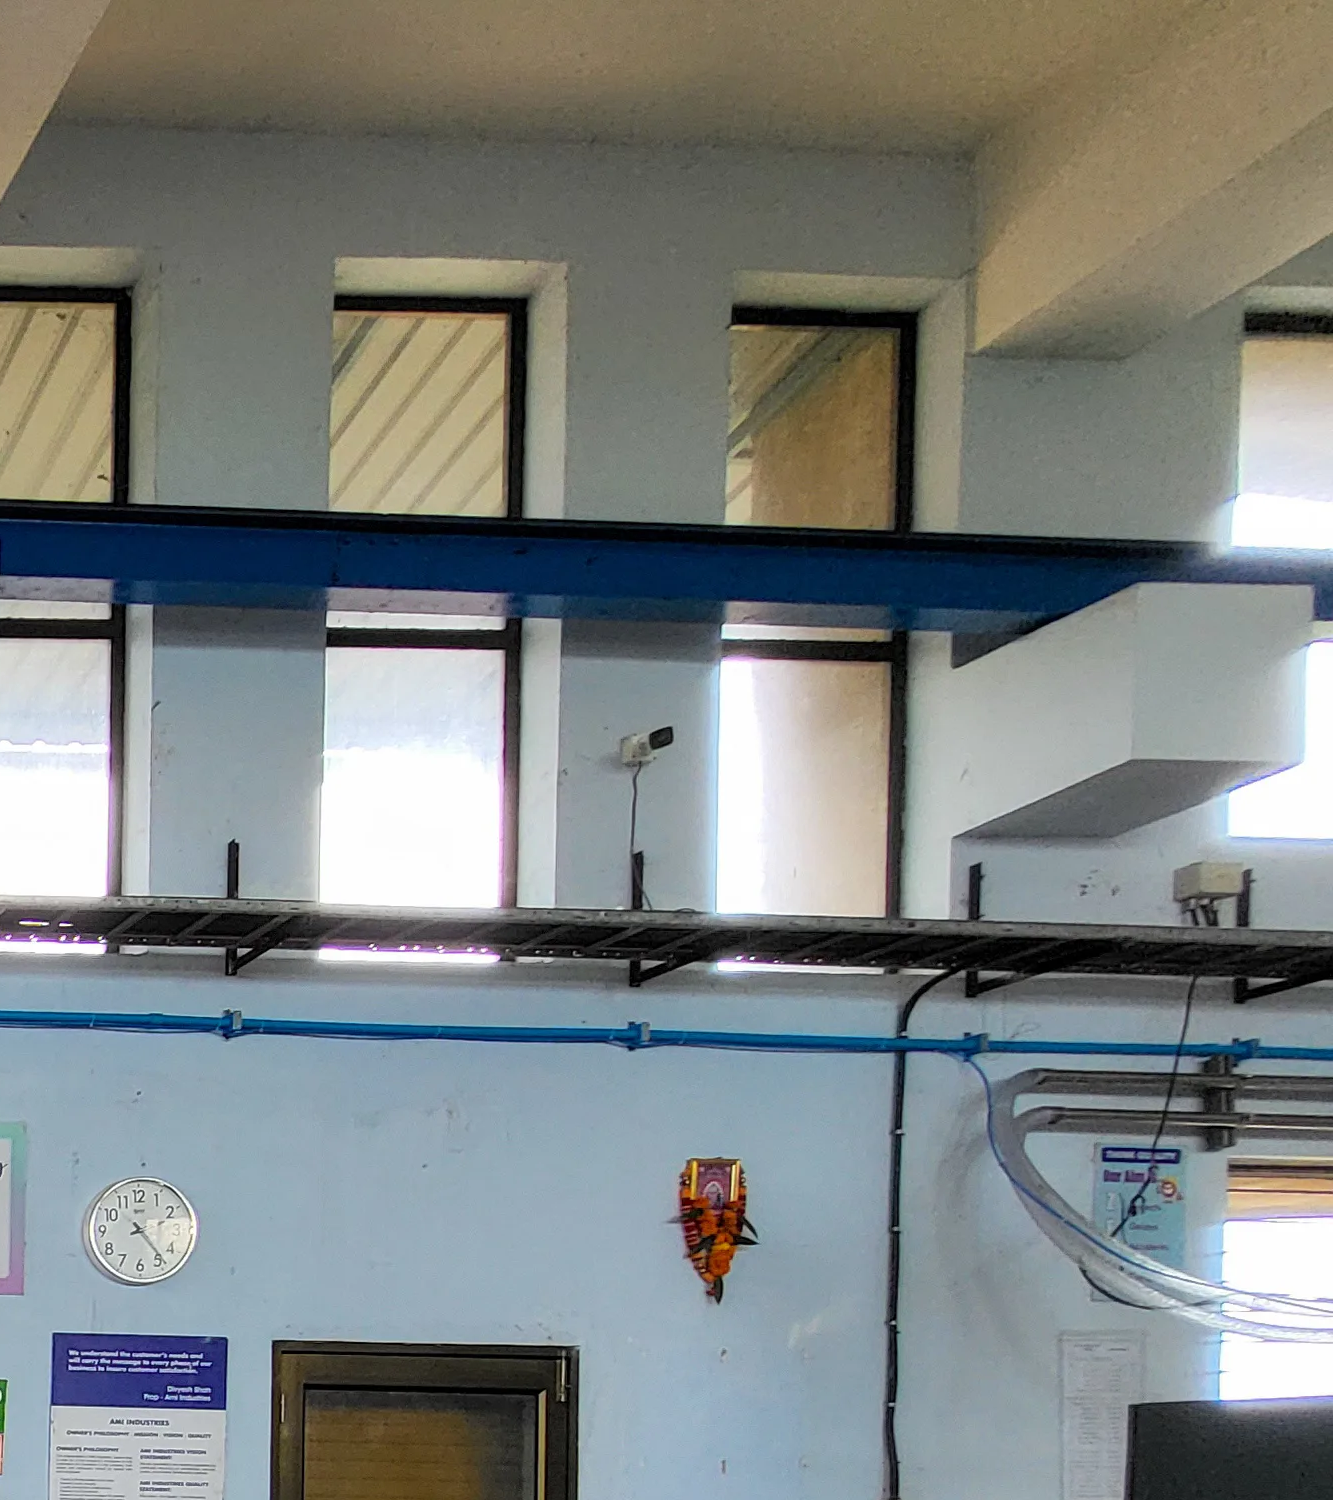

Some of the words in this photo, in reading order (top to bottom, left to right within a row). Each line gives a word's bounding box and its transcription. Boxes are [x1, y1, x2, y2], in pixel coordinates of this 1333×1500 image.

[117, 1195, 128, 1209] 11
[132, 1189, 145, 1203] 12
[154, 1193, 159, 1207] 1
[104, 1208, 118, 1222] 10
[165, 1205, 174, 1219] 2
[98, 1224, 107, 1238] 9
[104, 1242, 114, 1256] 8
[165, 1241, 174, 1255] 4
[118, 1253, 127, 1267] 7
[135, 1258, 145, 1272] 6
[126, 1418, 170, 1427] INDUSTRIES
